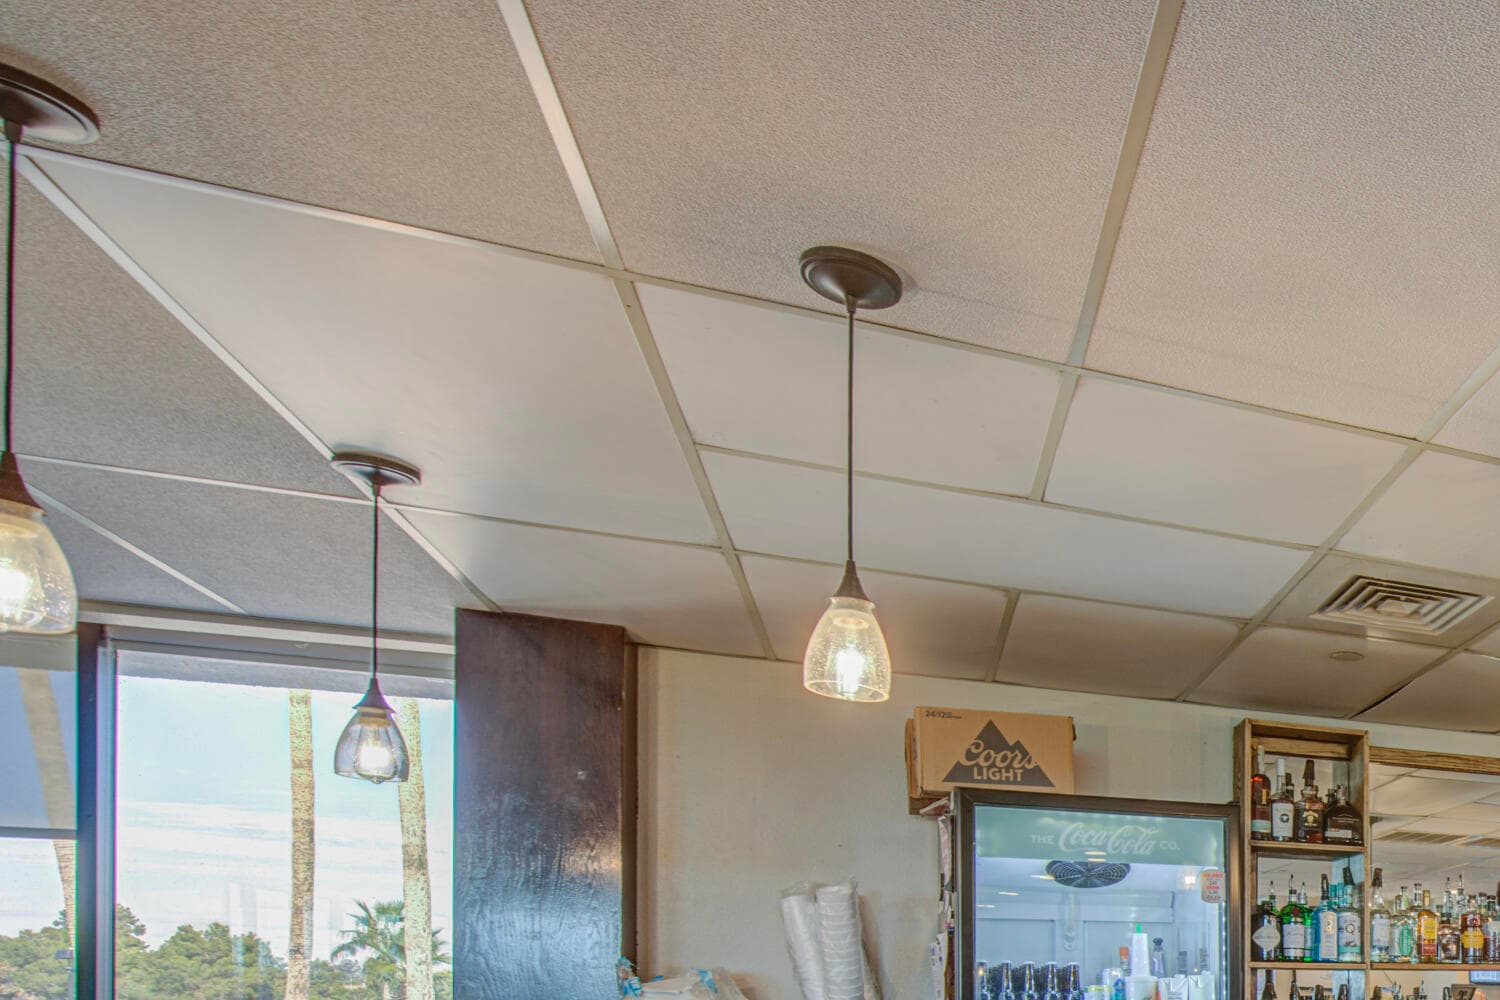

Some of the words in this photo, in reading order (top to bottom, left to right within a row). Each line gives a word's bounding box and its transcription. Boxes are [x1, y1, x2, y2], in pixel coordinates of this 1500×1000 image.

[960, 740, 1038, 769] Coors
[973, 767, 1024, 781] LIGHT
[1031, 834, 1054, 845] THE
[1059, 822, 1159, 855] Coca-Cola
[1160, 840, 1180, 850] CO.
